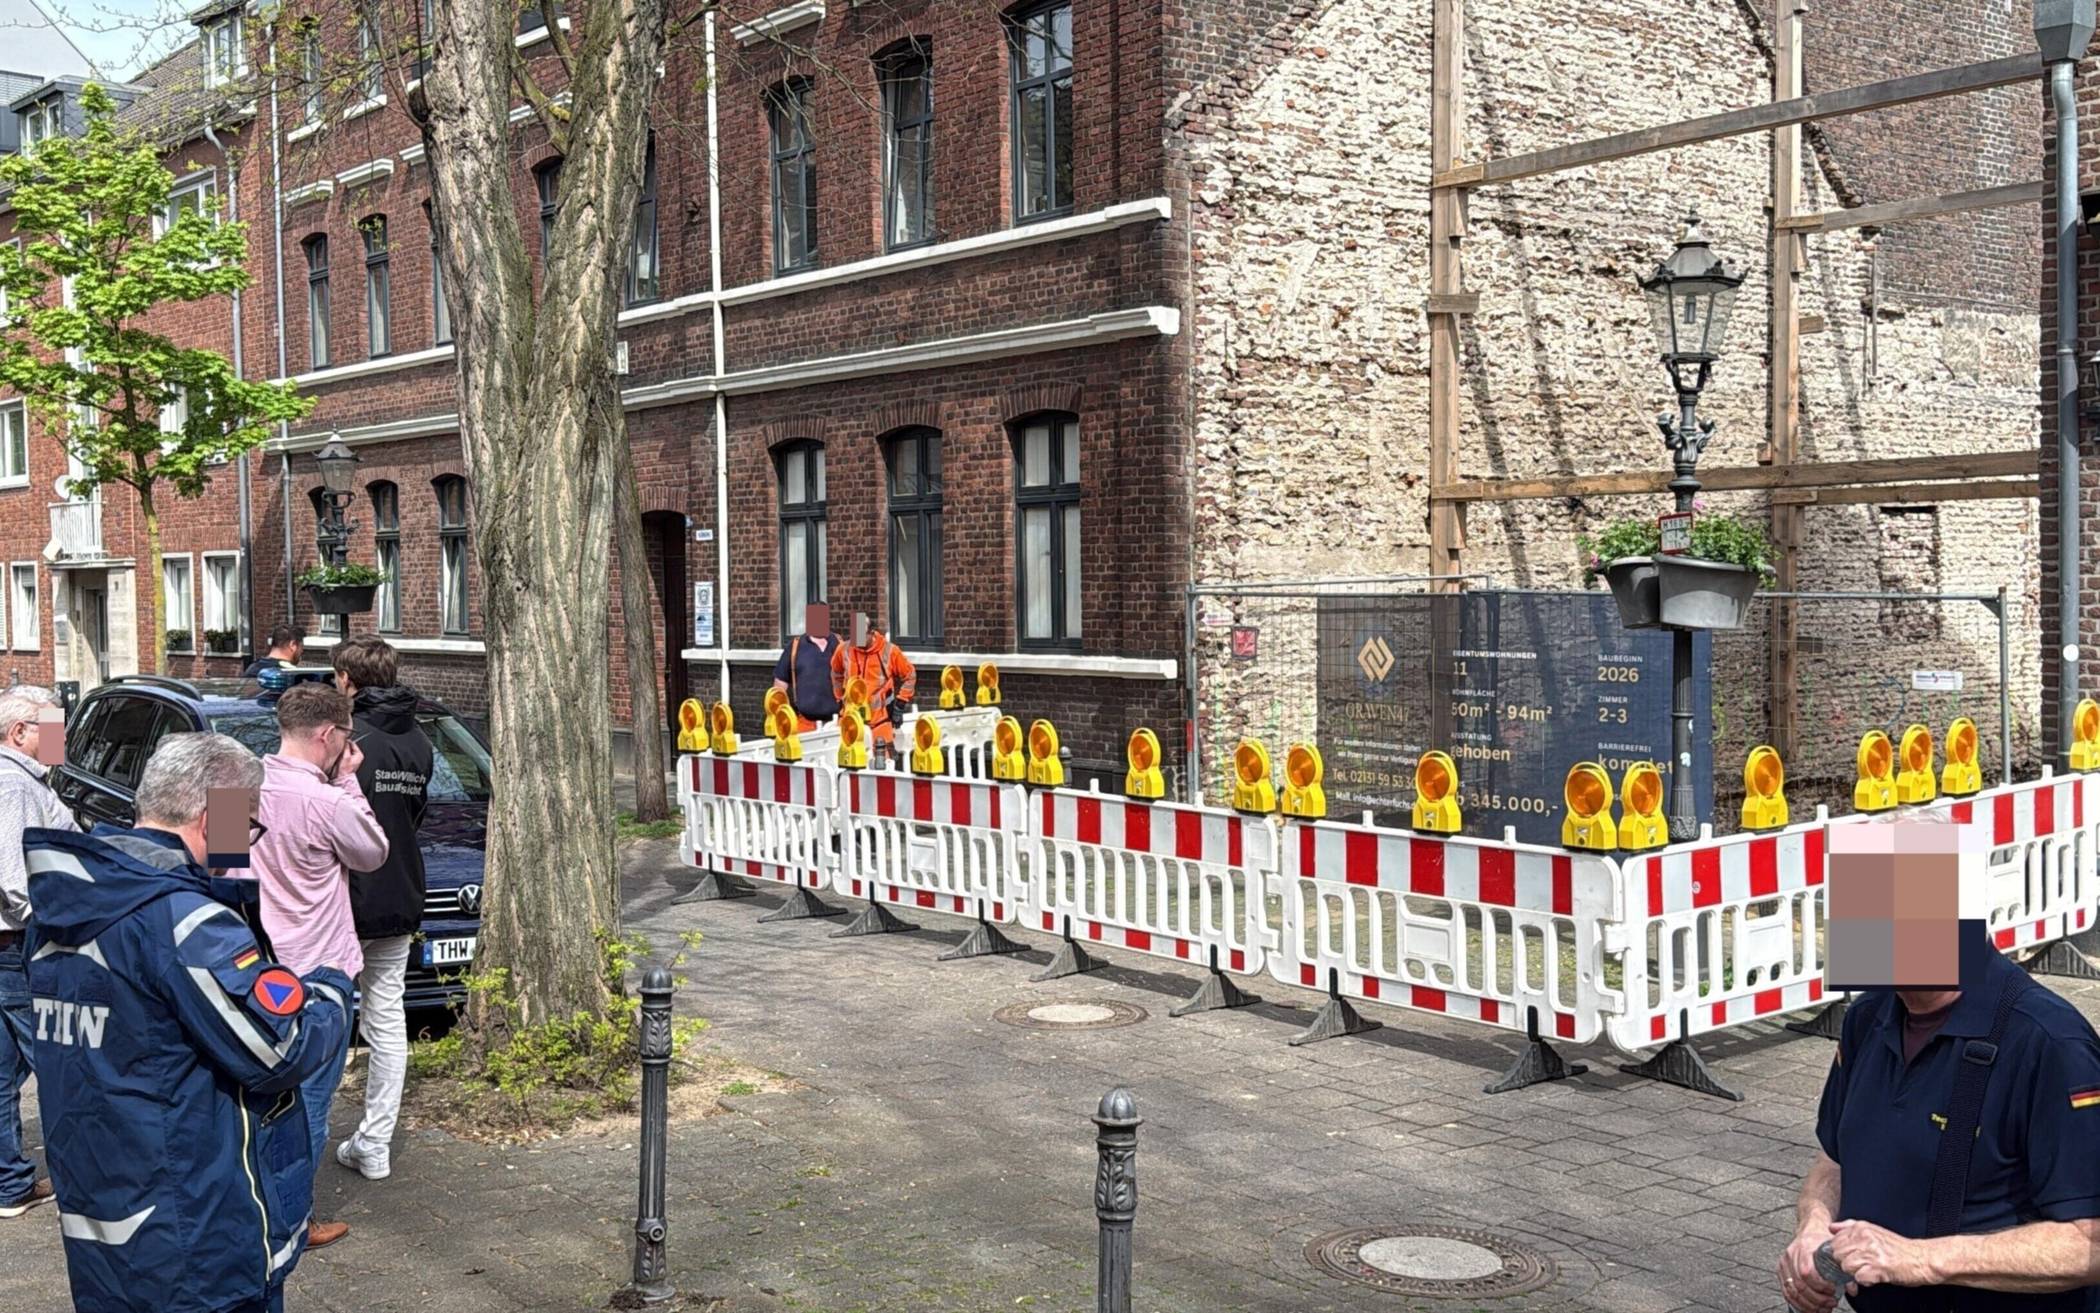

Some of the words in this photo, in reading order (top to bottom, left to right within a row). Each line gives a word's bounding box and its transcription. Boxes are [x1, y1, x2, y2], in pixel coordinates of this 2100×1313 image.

[1598, 654, 1643, 662] BAUBEGINN
[1453, 661, 1468, 676] 11
[1598, 666, 1640, 683] 2026
[1598, 695, 1628, 704] ZIMMER
[1507, 704, 1553, 721] 94m²
[1598, 707, 1628, 724] 2-3
[1450, 743, 1511, 761] gehoben
[1598, 742, 1652, 753] BARRIEREFREI
[1378, 773, 1391, 786] 59
[1470, 793, 1559, 817] 345.000,-
[437, 940, 468, 960] THW
[32, 997, 110, 1049] THW
